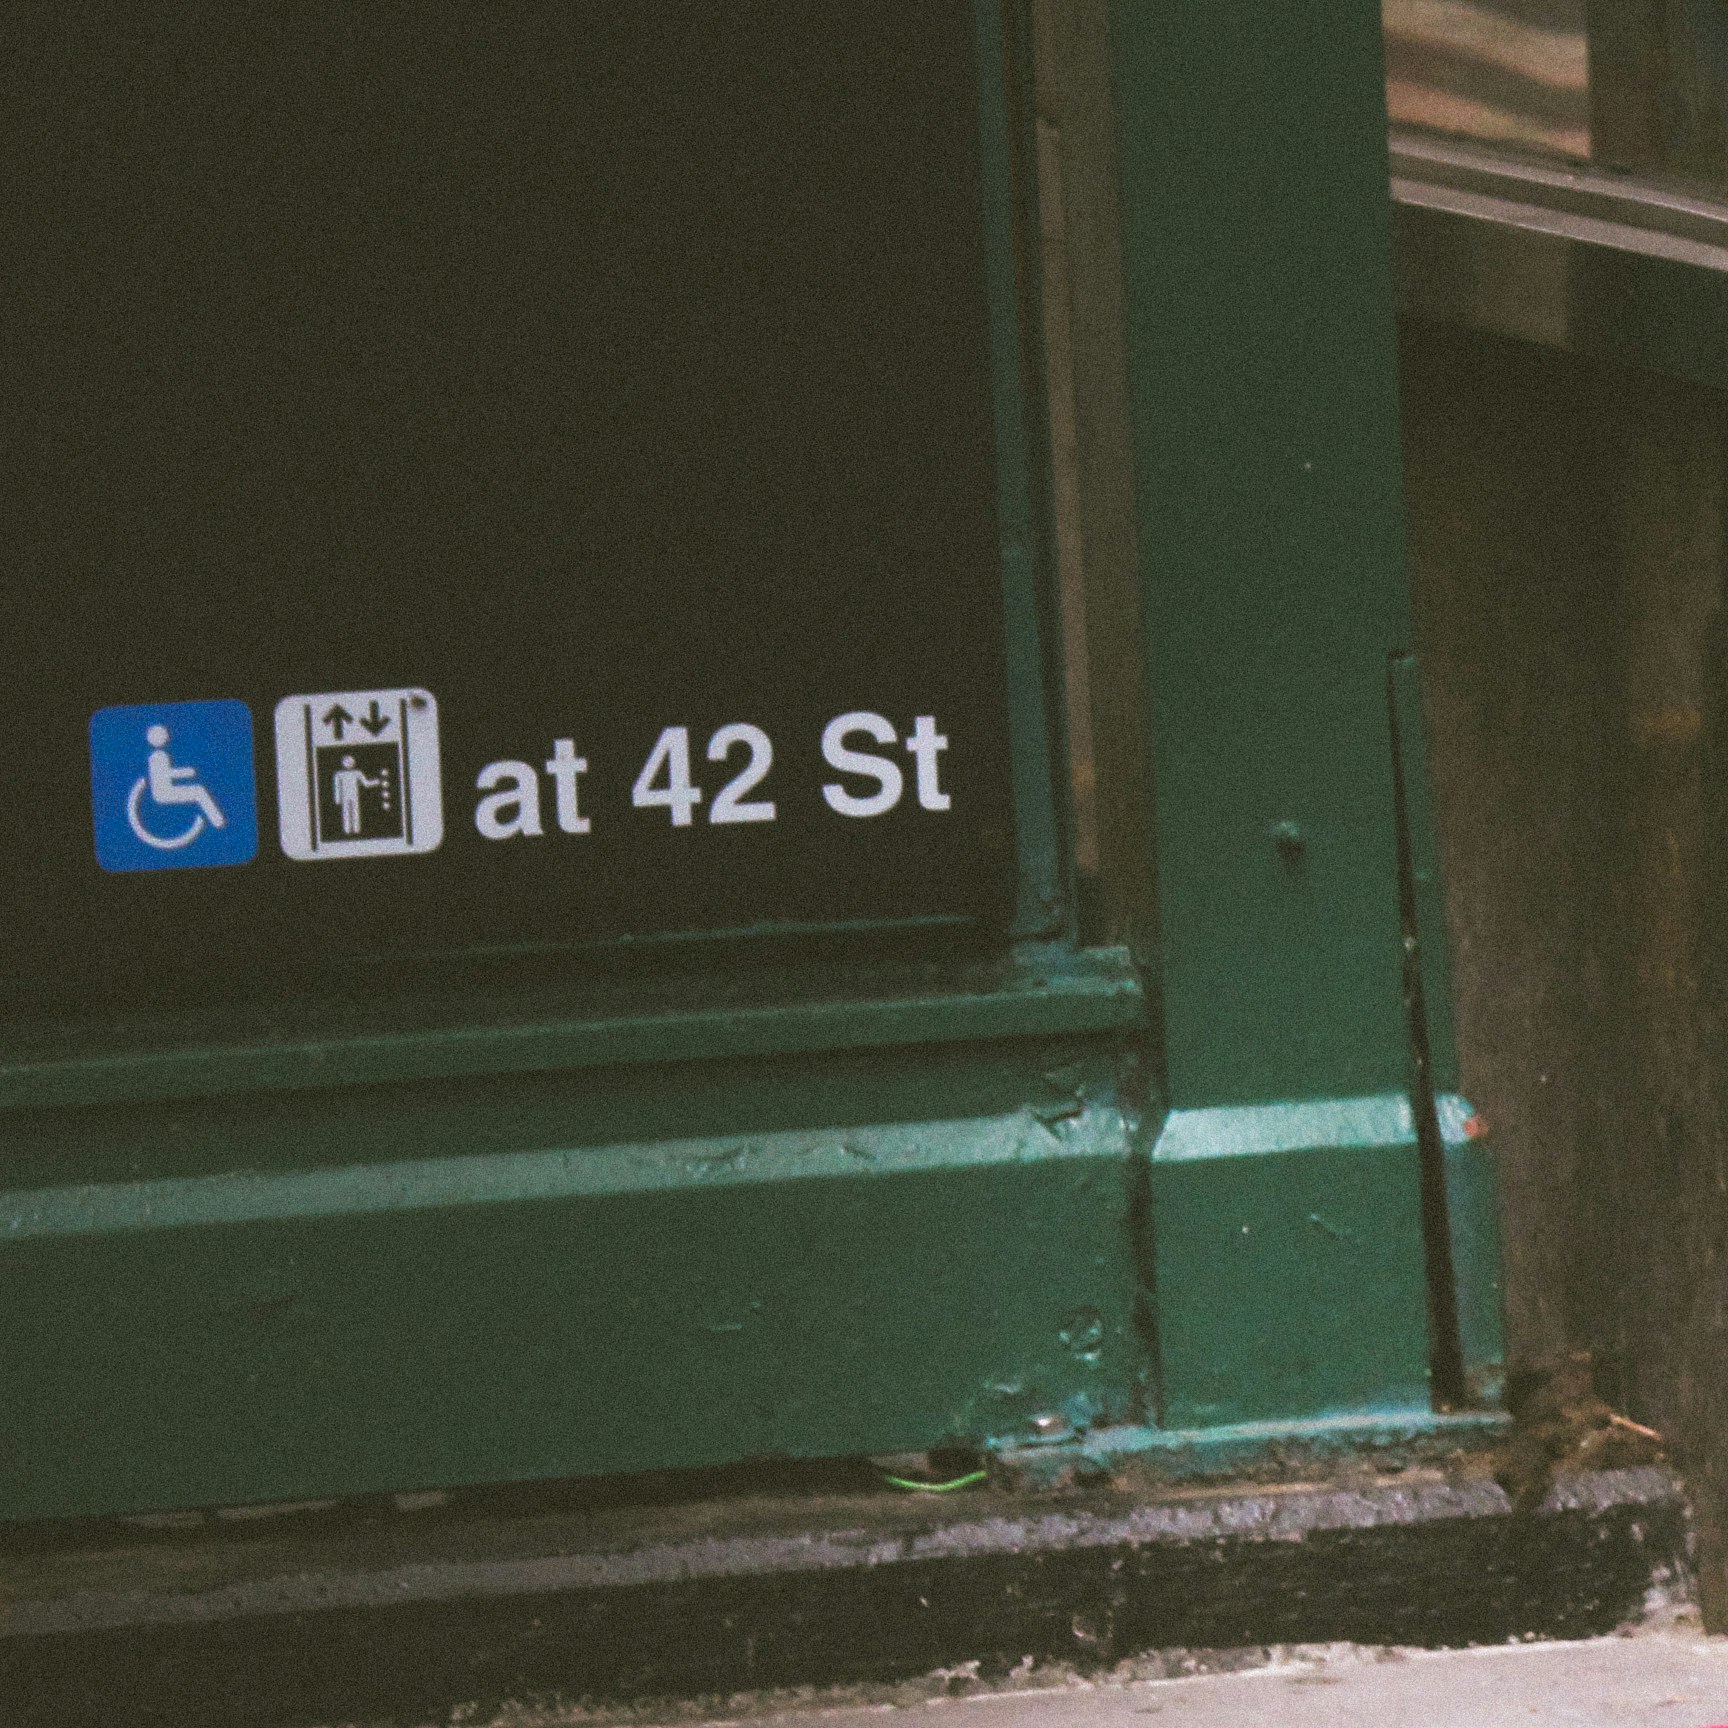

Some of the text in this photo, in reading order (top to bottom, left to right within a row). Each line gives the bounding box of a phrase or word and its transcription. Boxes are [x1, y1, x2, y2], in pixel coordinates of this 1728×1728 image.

[474, 711, 950, 840] at 42 St
